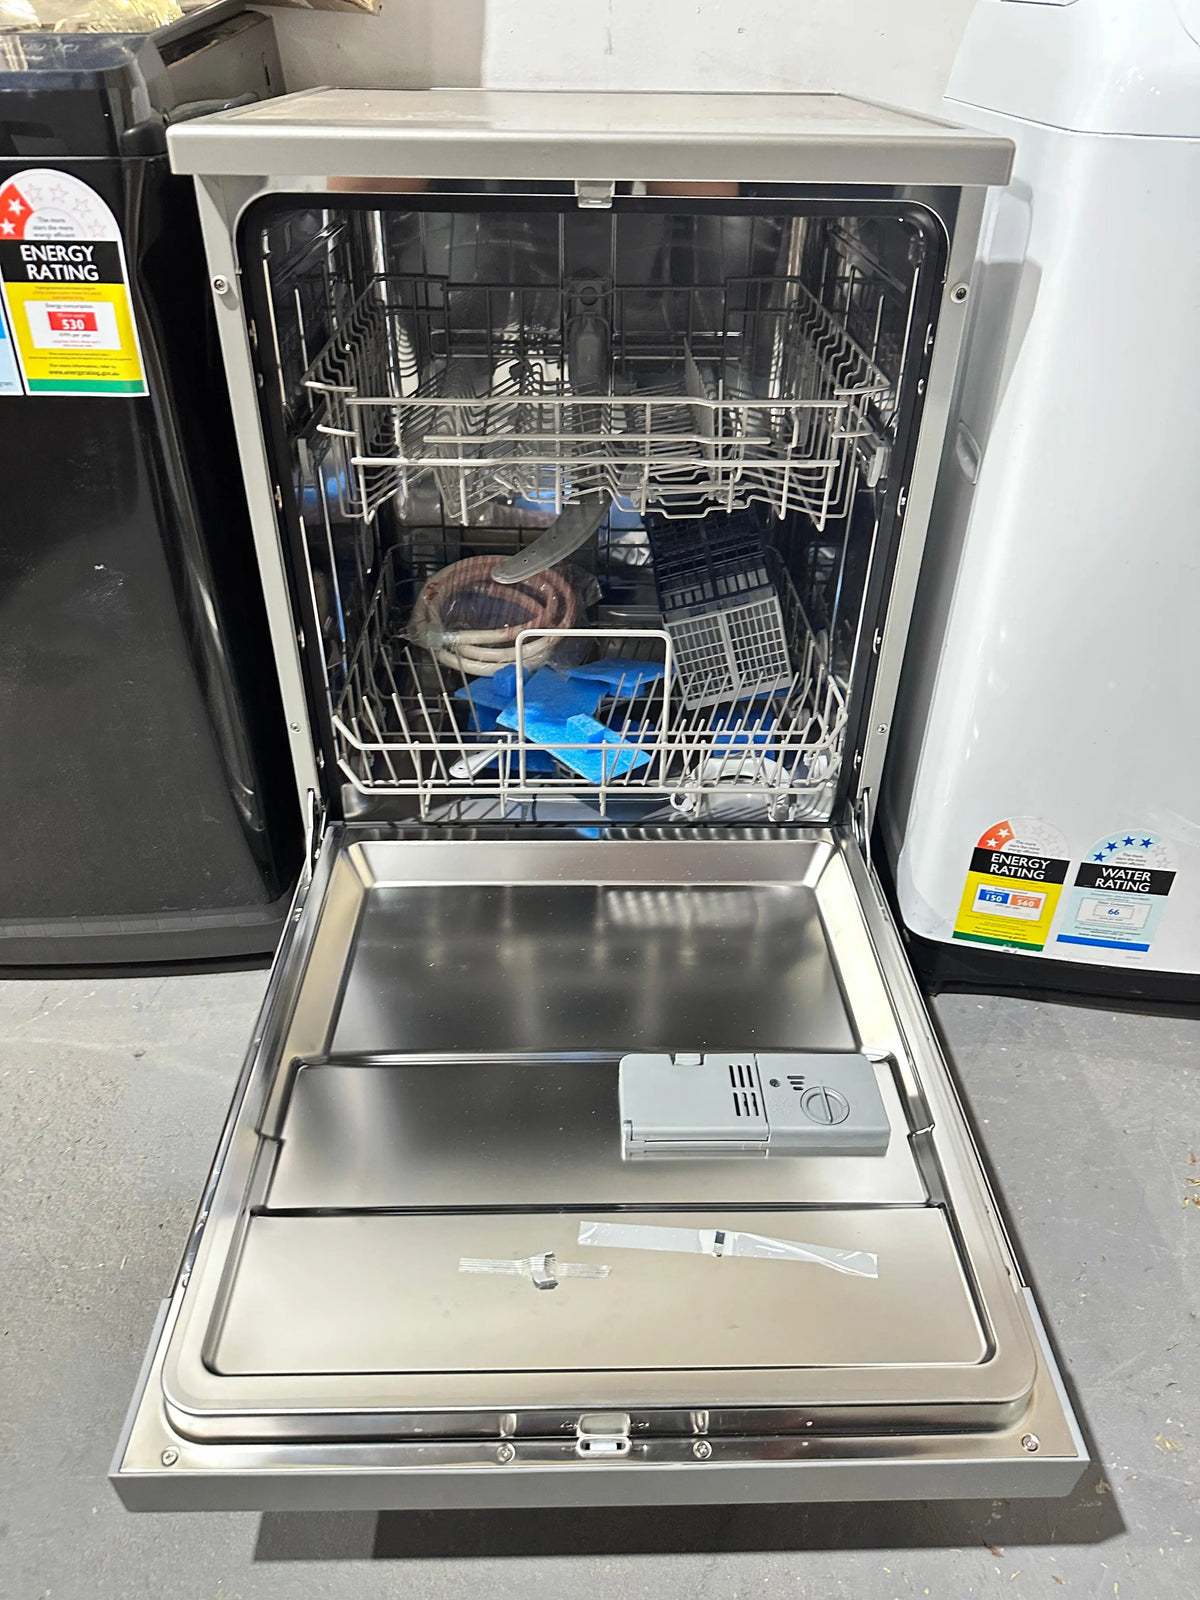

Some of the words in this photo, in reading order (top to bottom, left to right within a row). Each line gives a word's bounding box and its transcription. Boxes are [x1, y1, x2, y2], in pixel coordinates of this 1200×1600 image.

[20, 245, 94, 262] ENERGY
[26, 264, 99, 281] RATING
[62, 319, 85, 330] 530
[991, 853, 1051, 870] ENERGY
[989, 864, 1045, 880] RATING
[1102, 867, 1151, 882] WATER
[1095, 878, 1151, 893] RATING
[985, 894, 1003, 903] 150
[1017, 899, 1035, 907] 560
[1107, 908, 1120, 916] 66
